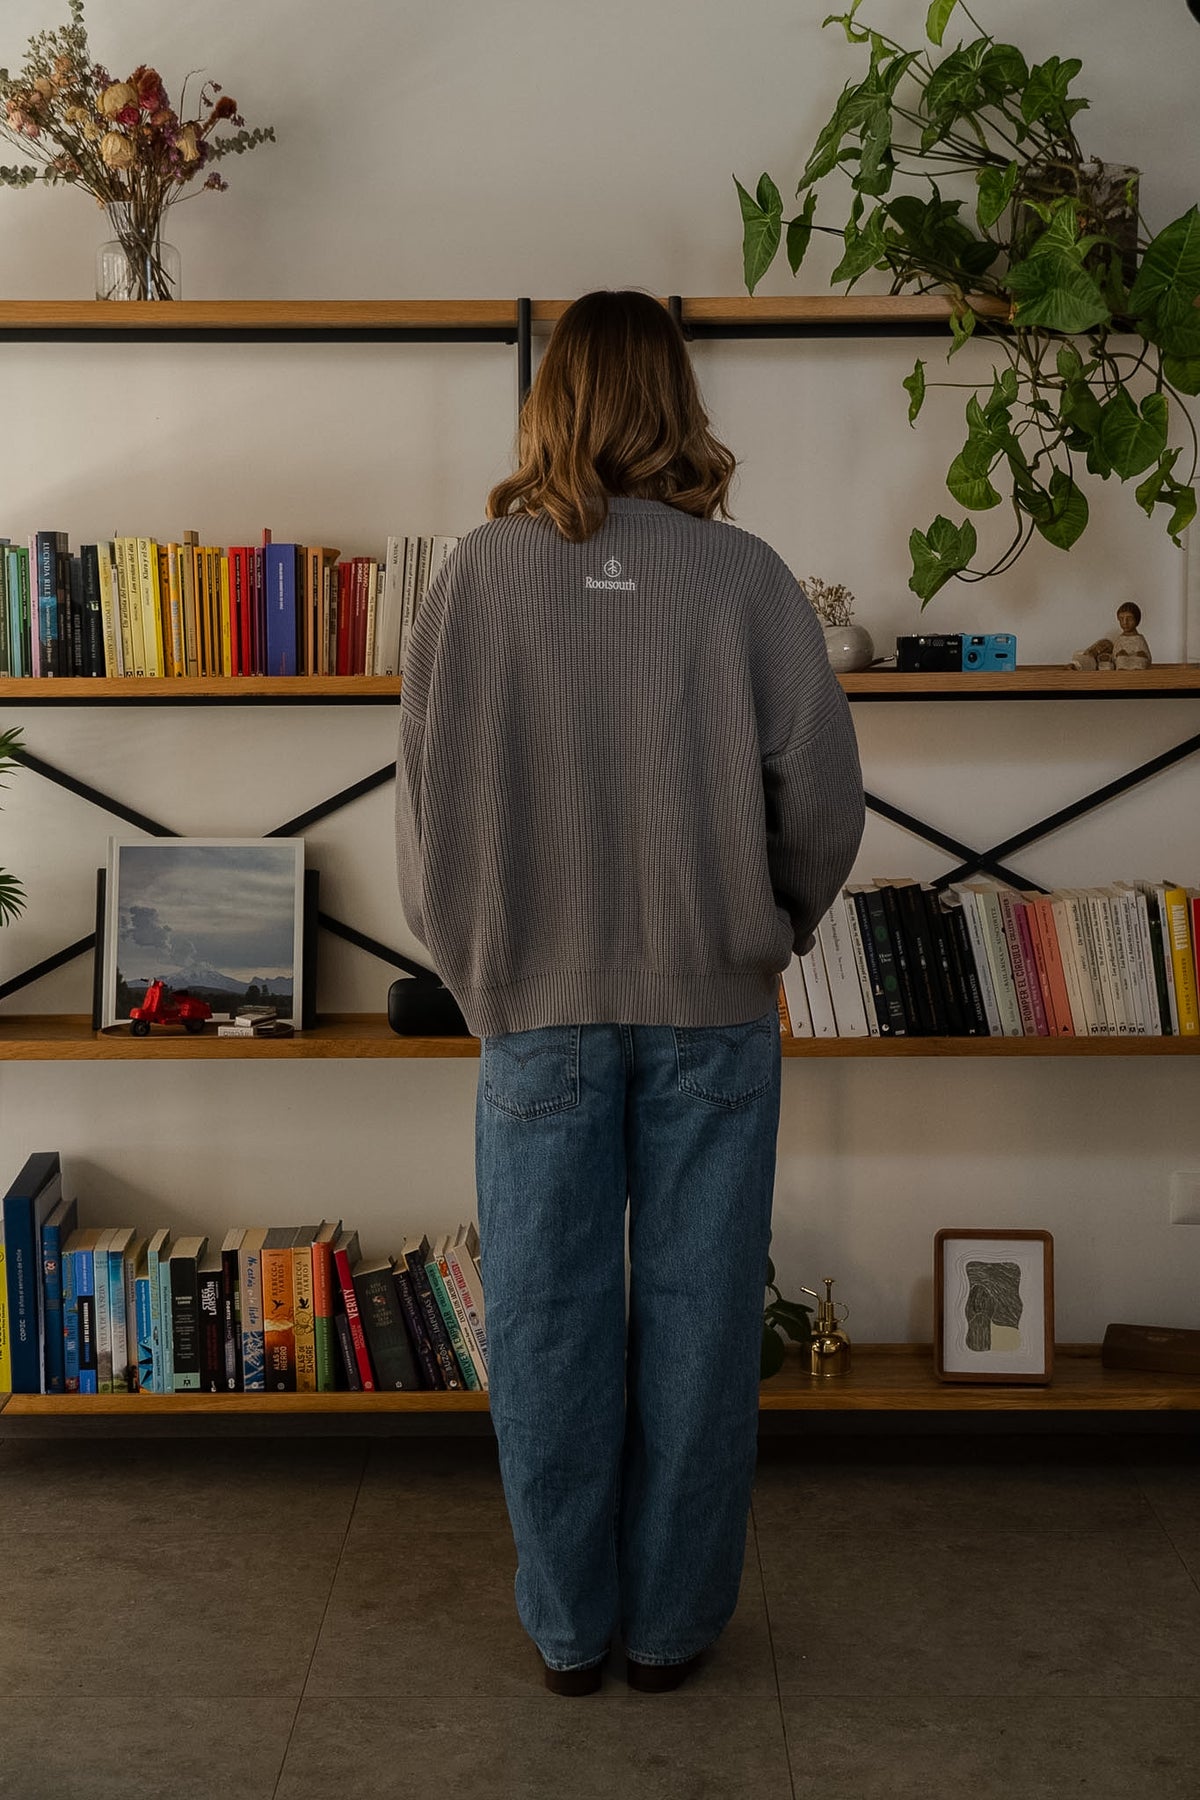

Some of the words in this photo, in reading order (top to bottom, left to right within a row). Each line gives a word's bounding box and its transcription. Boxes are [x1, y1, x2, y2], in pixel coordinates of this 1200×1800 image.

[43, 542, 51, 577] LUCINDA
[585, 576, 636, 590] Rootsouth
[1003, 899, 1011, 918] HOOVER
[1072, 905, 1080, 922] terrible
[991, 907, 1000, 944] AUSCHWITZ
[1008, 919, 1016, 941] COLLEEN
[1171, 904, 1189, 951] AMARILLA
[1181, 957, 1189, 985] REBECCA
[1000, 953, 1009, 987] BAILARINA
[1012, 944, 1024, 976] CÍRCULO
[1018, 978, 1026, 987] EL
[1020, 989, 1033, 1021] ROMPER
[247, 1257, 258, 1266] No
[247, 1268, 256, 1287] estás
[446, 1279, 456, 1299] ARCHIVOS
[201, 1288, 209, 1310] STIEG
[206, 1281, 217, 1316] LARSSON
[344, 1288, 359, 1319] VERITY
[248, 1307, 260, 1325] lista
[424, 1298, 440, 1334] IMPURAS
[457, 1308, 465, 1322] ENTRE
[19, 1320, 27, 1342] COPEC
[444, 1311, 460, 1343] EMPEZAR
[272, 1354, 280, 1370] ALAS
[280, 1346, 288, 1371] HIERRO
[297, 1354, 305, 1373] ALAS
[306, 1345, 314, 1373] SANGRE
[438, 1343, 452, 1371] BUZÓN
[460, 1352, 474, 1379] VOLVER
